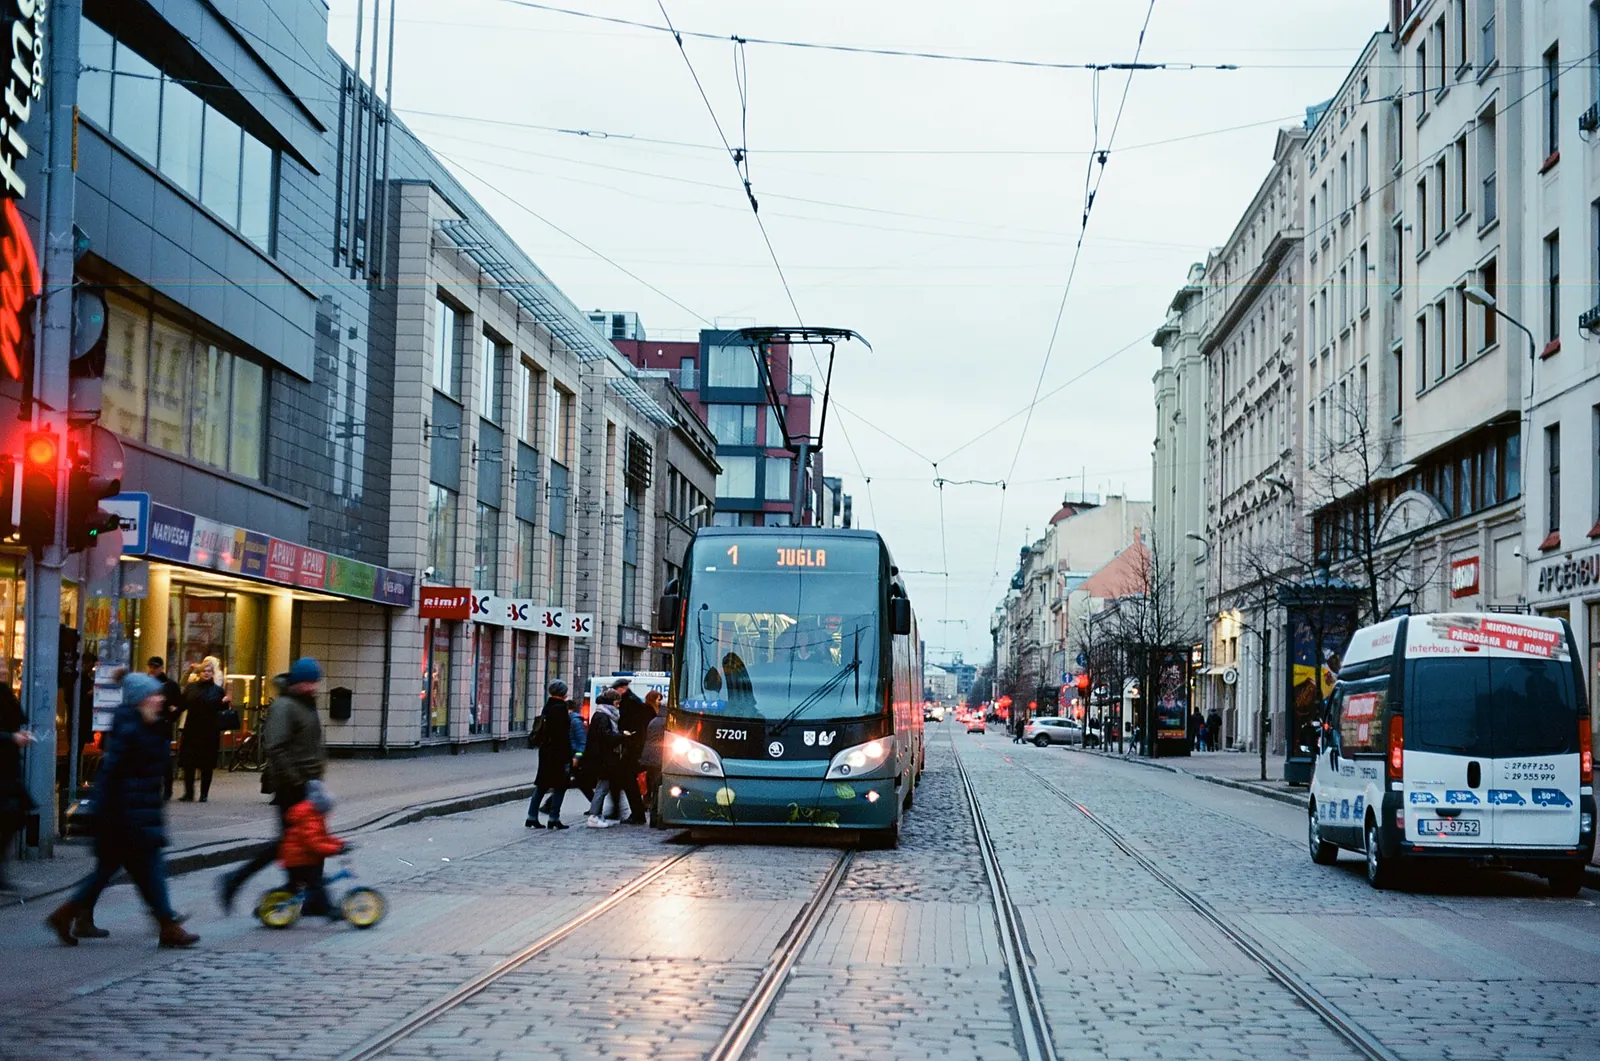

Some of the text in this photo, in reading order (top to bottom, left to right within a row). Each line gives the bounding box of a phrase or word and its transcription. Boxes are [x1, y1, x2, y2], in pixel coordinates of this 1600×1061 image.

[151, 522, 190, 547] NARVESEN
[271, 542, 296, 567] APAVU
[302, 551, 324, 573] APAVU
[727, 544, 826, 567] 1 JUGLA
[1486, 621, 1555, 642] MIKROAUTOBUSU
[1409, 644, 1461, 654] interbus.lv
[1506, 639, 1519, 650] UN
[1523, 643, 1548, 655] NOMA
[715, 729, 747, 740] 57201
[1426, 821, 1478, 833] LJ-9752
